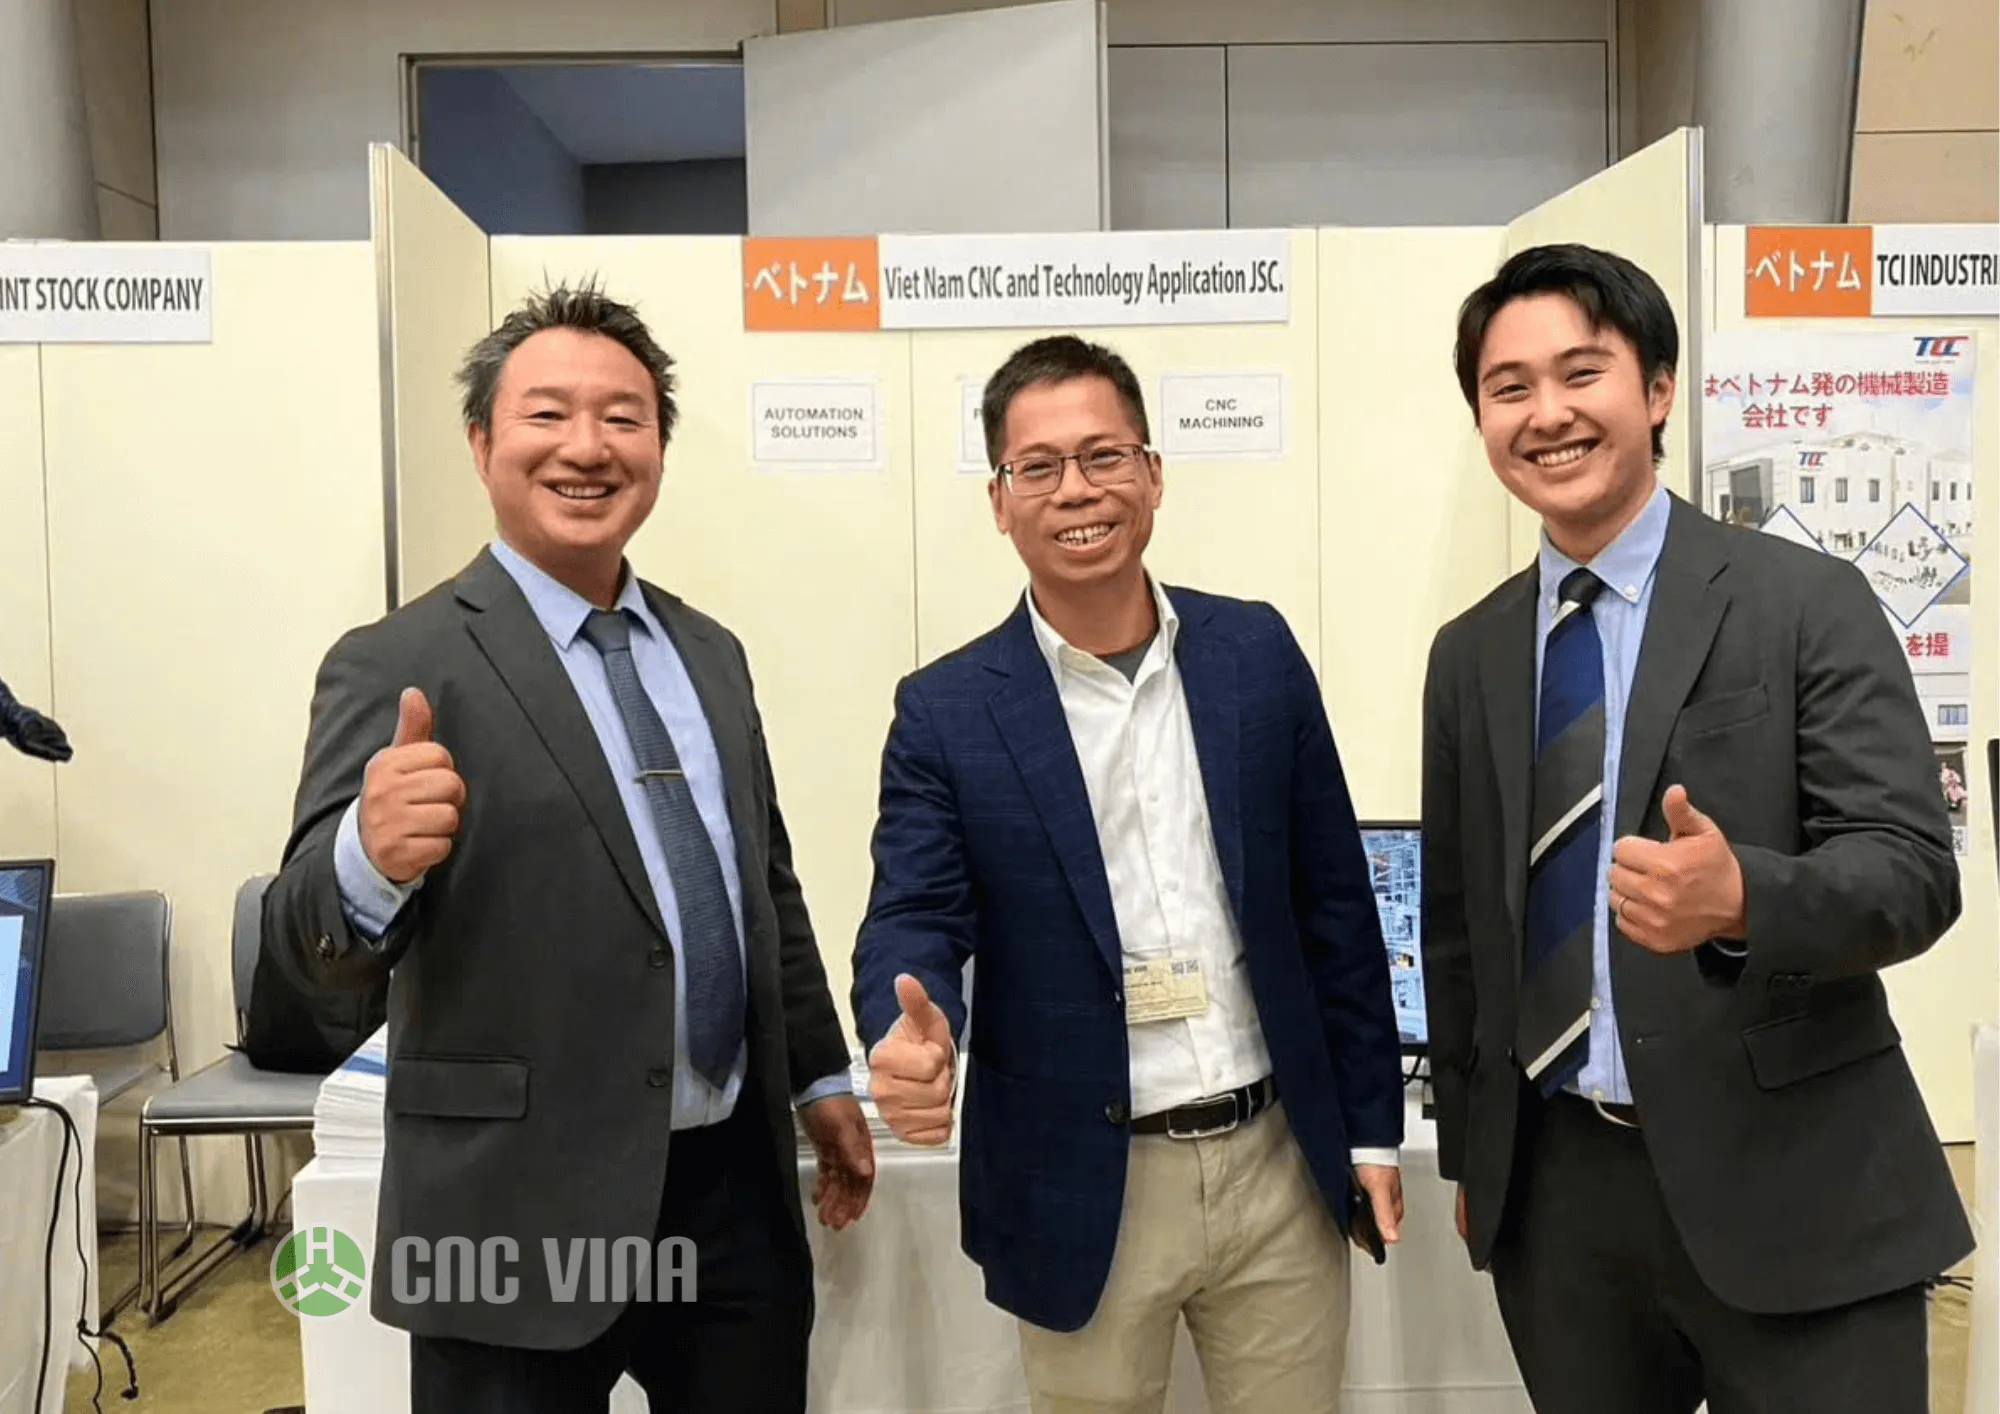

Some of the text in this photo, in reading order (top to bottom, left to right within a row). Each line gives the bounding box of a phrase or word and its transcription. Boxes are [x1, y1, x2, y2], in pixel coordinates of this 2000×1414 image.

[753, 260, 869, 305] ベトナム
[884, 260, 1284, 305] Viet Nam CNC and Technology Application JSC.
[1755, 249, 1862, 292] ベトナム
[1876, 254, 1998, 286] TCI INDUSTRI
[35, 277, 100, 311] STOCK
[104, 277, 204, 311] COMPANY
[764, 407, 864, 421] AUTOMATION
[1205, 398, 1238, 412] CNC
[1742, 402, 1833, 429] 会社です
[770, 425, 859, 439] SOLUTIONS
[1179, 415, 1264, 430] MACHINING
